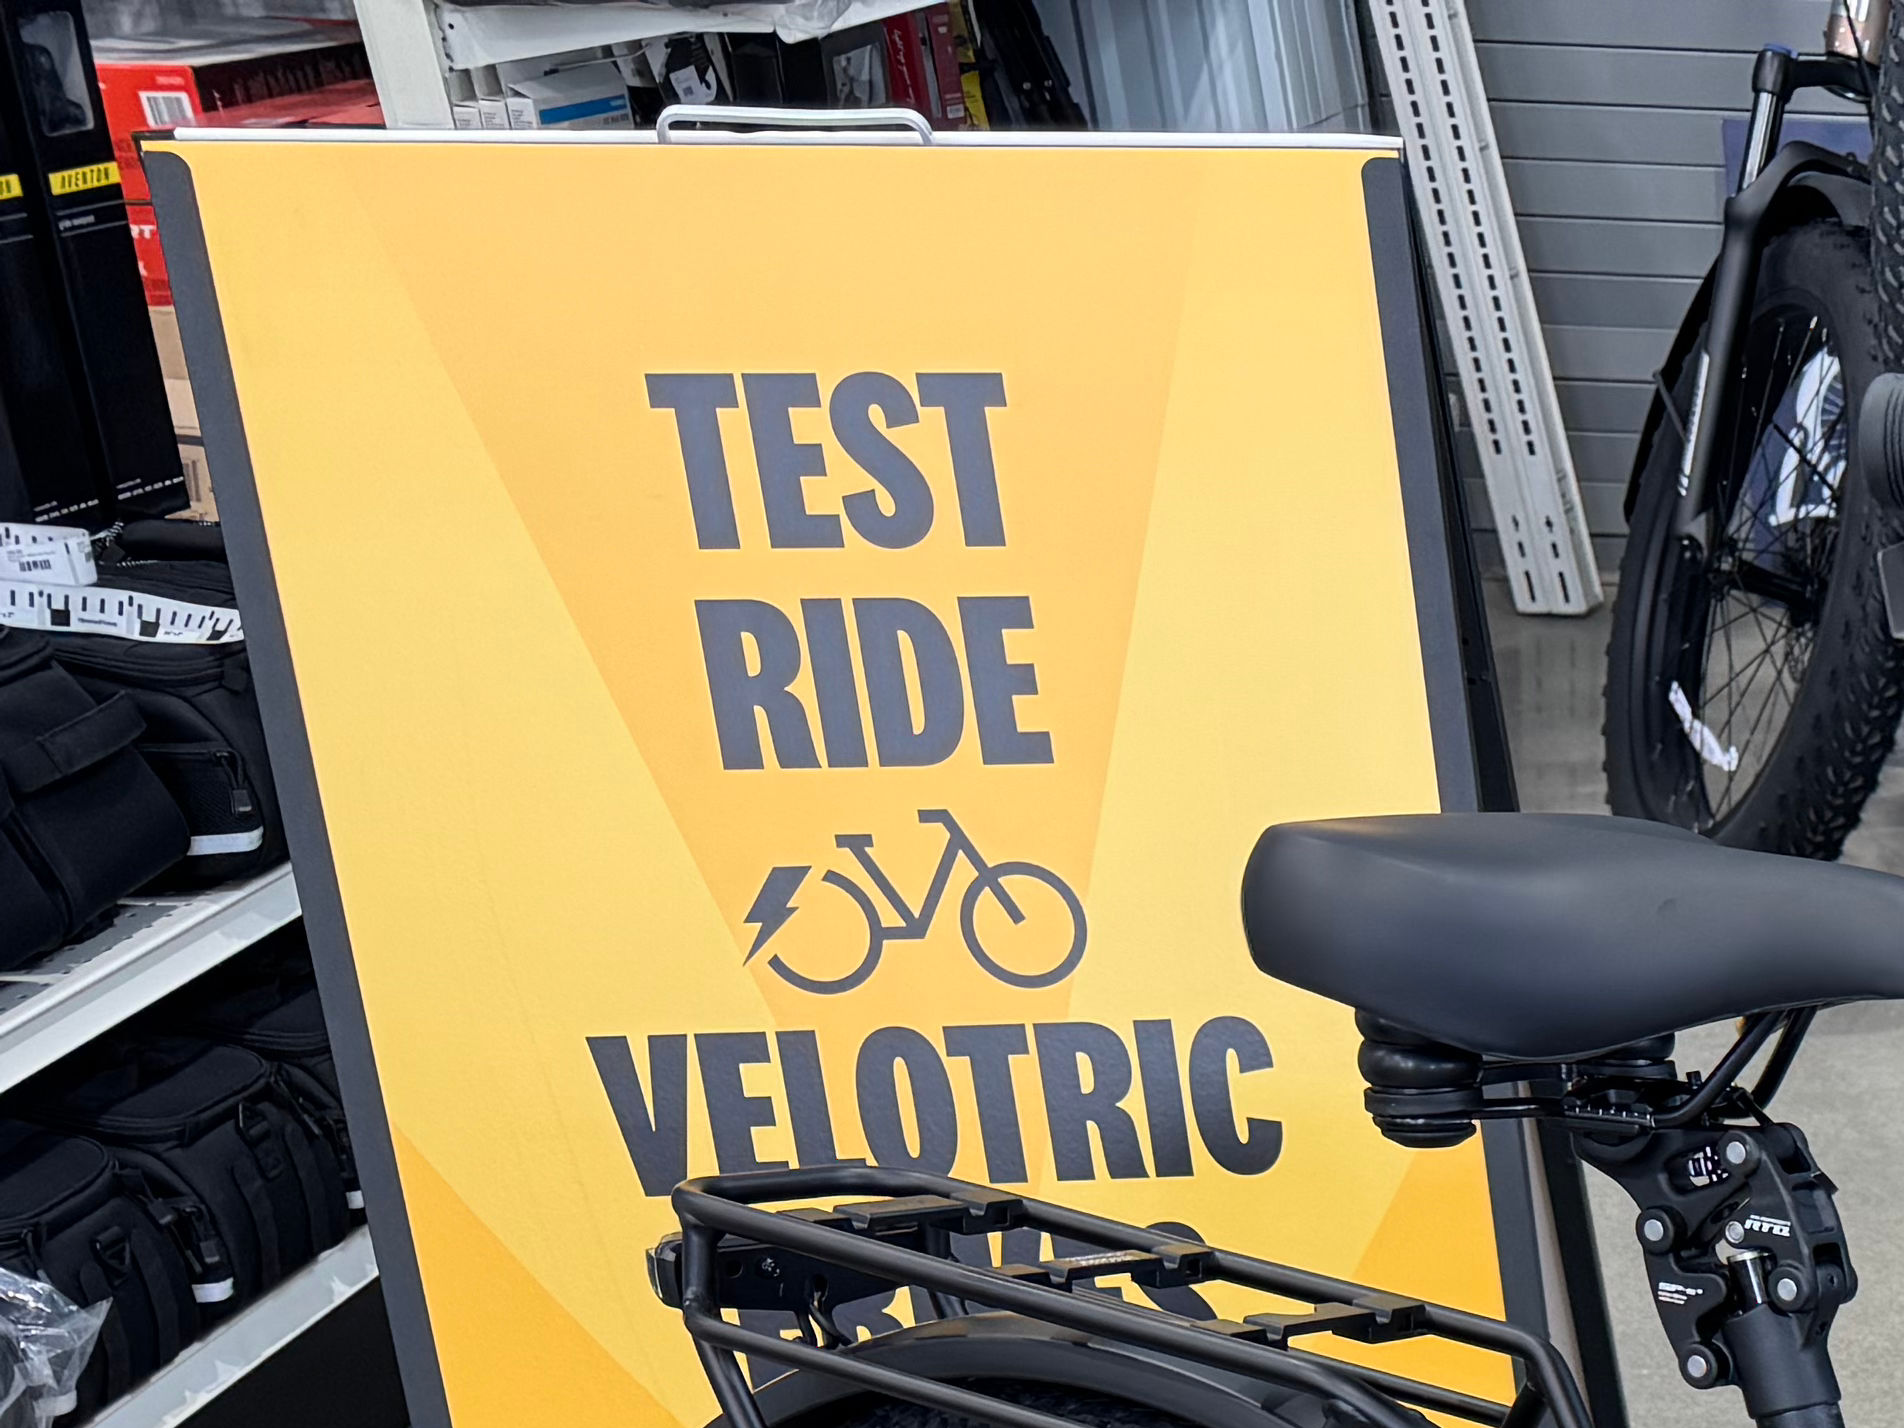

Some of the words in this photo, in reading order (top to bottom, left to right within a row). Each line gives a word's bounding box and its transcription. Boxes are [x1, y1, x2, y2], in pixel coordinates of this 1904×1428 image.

[645, 372, 1007, 549] TEST
[695, 597, 1053, 769] RIDE
[586, 1016, 1283, 1200] VELOTRIC
